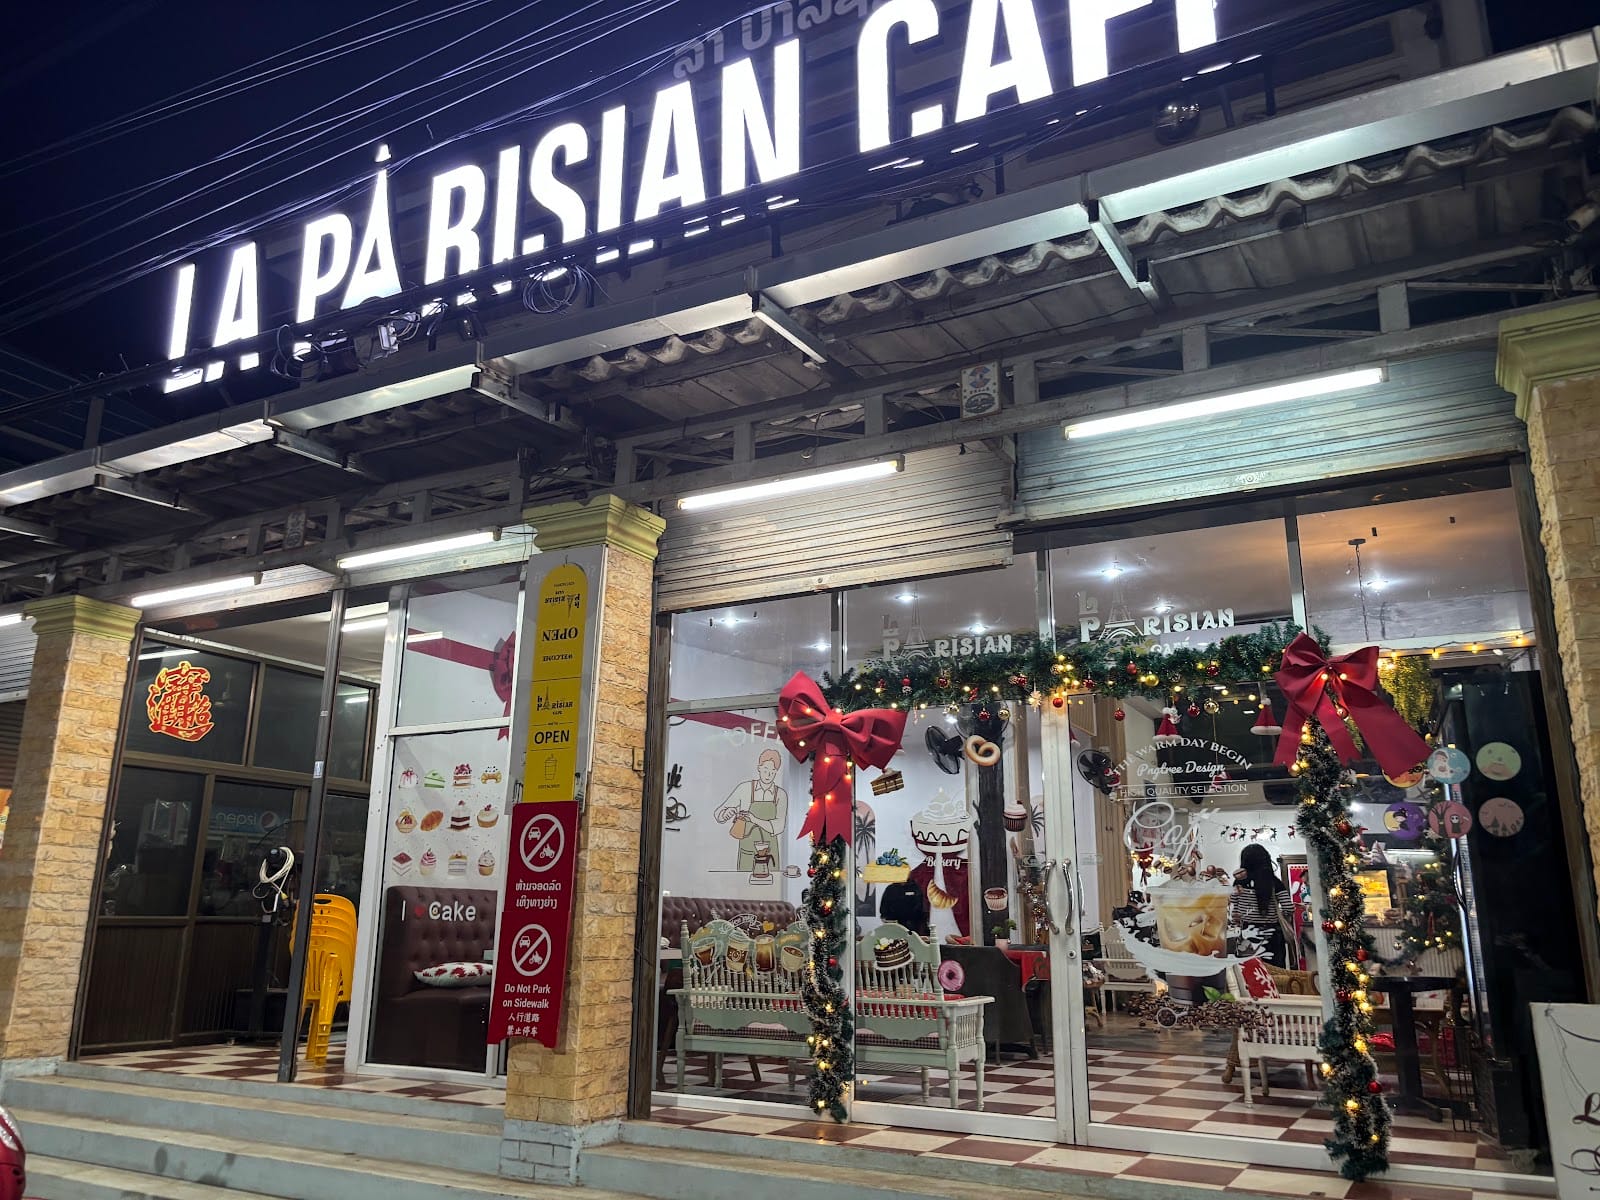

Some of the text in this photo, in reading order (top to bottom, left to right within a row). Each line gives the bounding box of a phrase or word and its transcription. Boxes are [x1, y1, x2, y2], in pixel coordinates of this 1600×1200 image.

[163, 241, 261, 394] LA
[292, 38, 801, 363] PARISIAN
[541, 627, 579, 643] OPEN
[534, 729, 570, 745] OPEN
[1112, 737, 1253, 776] THE WARM DAY BEGIN
[1136, 760, 1226, 780] Pngtree Design
[1120, 783, 1248, 798] HIGH QUALITY SELECTION
[926, 855, 962, 871] Bkery
[401, 900, 477, 922] I Cake
[504, 983, 551, 994] Do Not Park
[502, 998, 549, 1009] on Sidewalk
